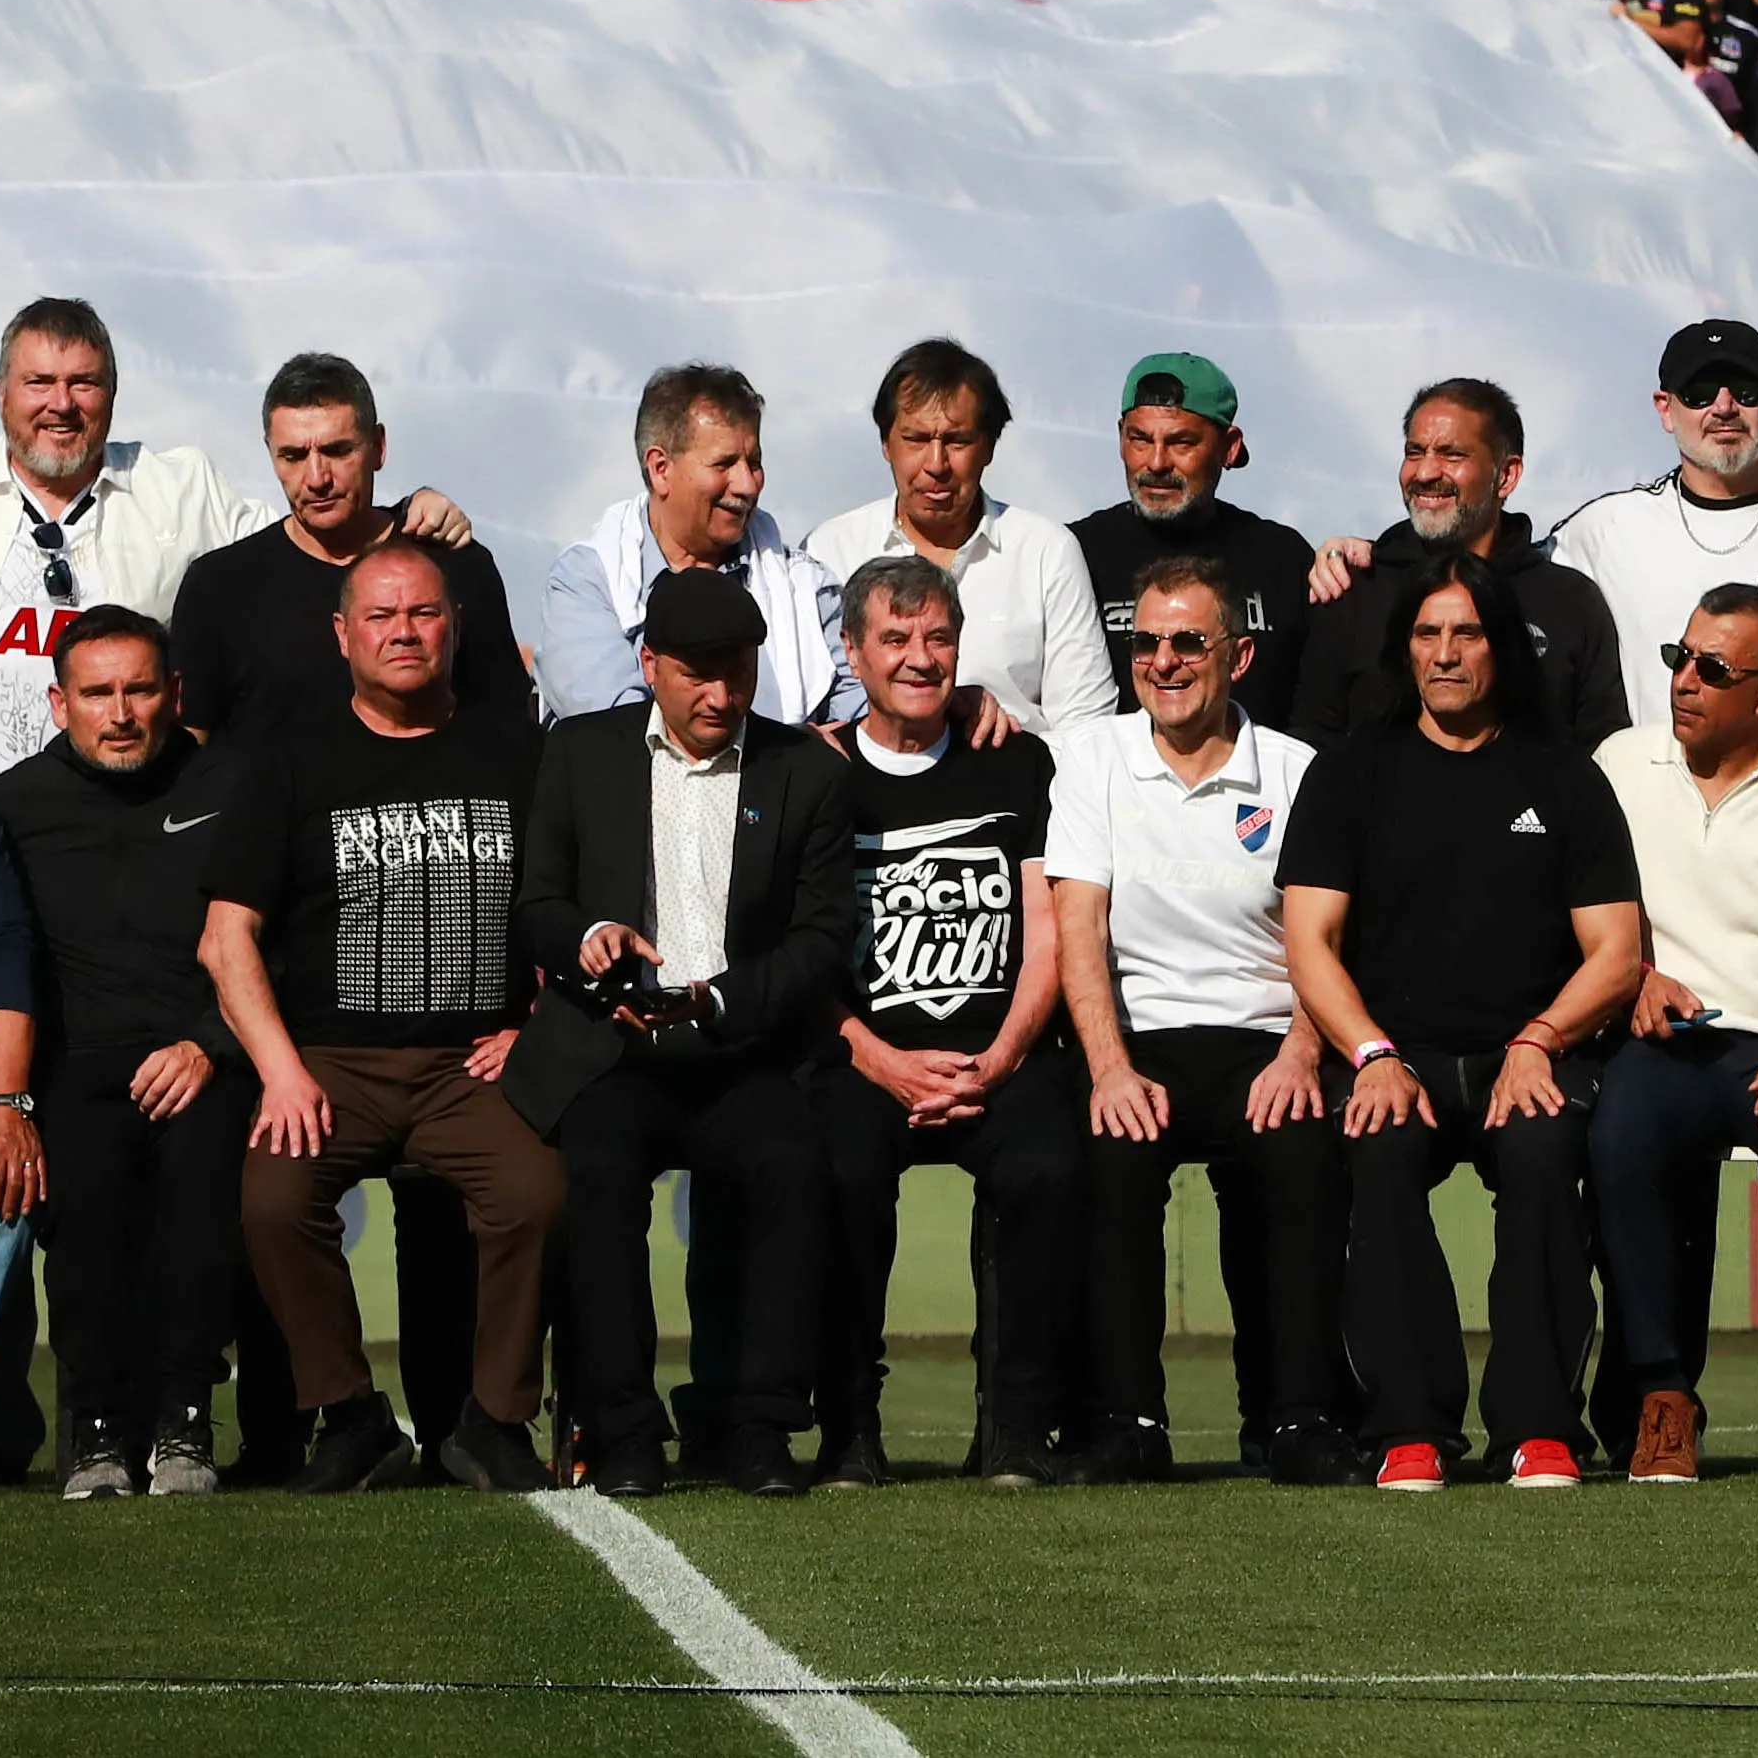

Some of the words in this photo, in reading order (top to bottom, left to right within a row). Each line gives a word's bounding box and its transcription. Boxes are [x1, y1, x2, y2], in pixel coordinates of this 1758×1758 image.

[339, 808, 463, 841] ARMANI
[1510, 823, 1547, 834] adidas
[339, 833, 513, 871] EXCHANGE
